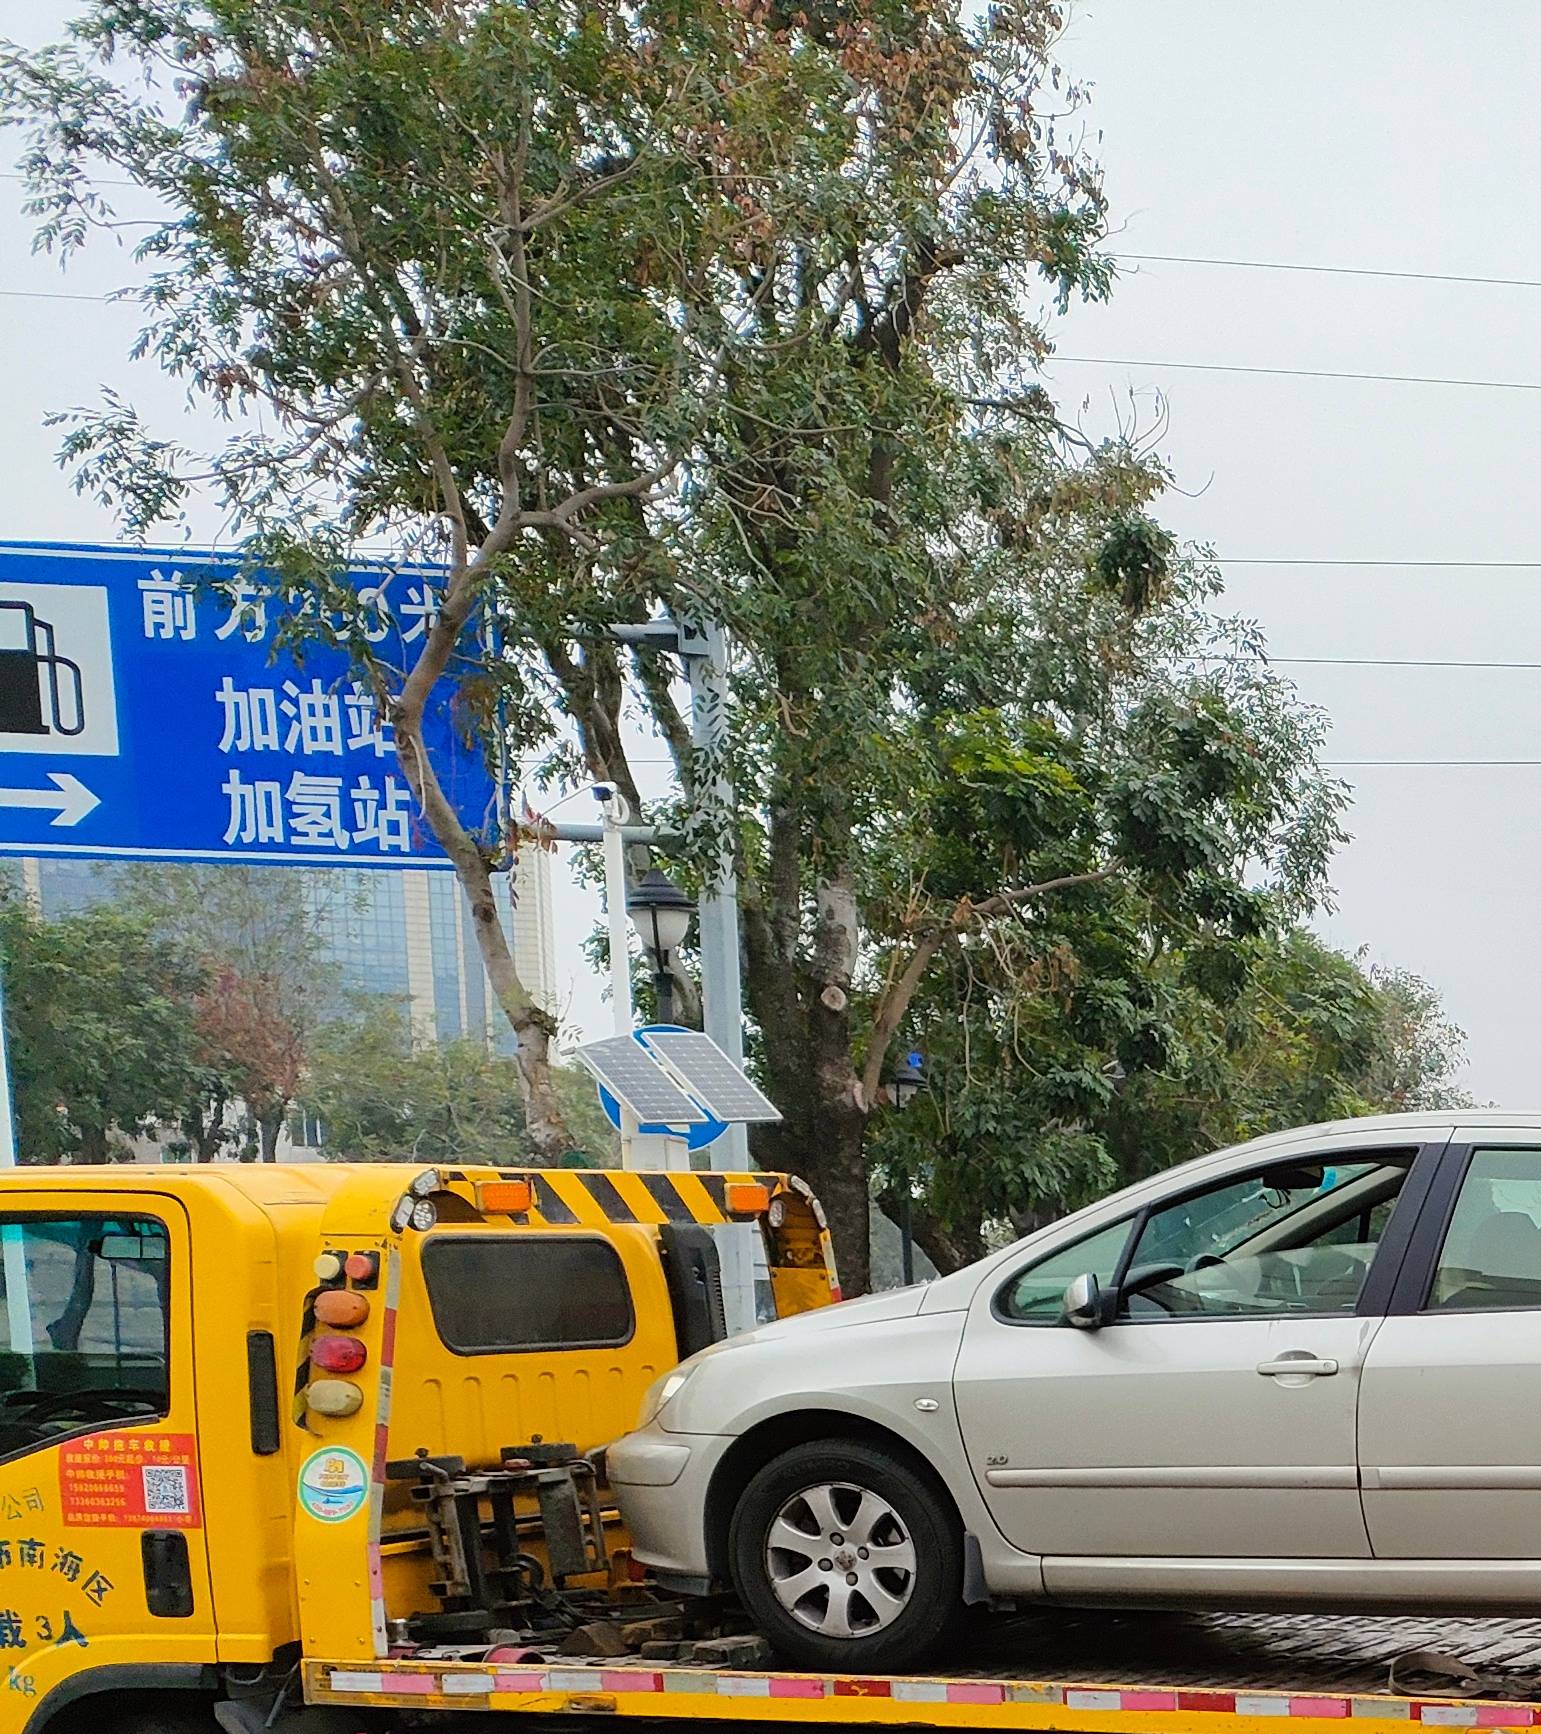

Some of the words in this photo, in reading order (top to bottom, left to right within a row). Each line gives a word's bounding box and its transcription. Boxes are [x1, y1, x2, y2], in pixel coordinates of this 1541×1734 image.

[215, 677, 402, 757] 加油站
[222, 769, 411, 852] 加氢站
[8, 1665, 37, 1697] kg
